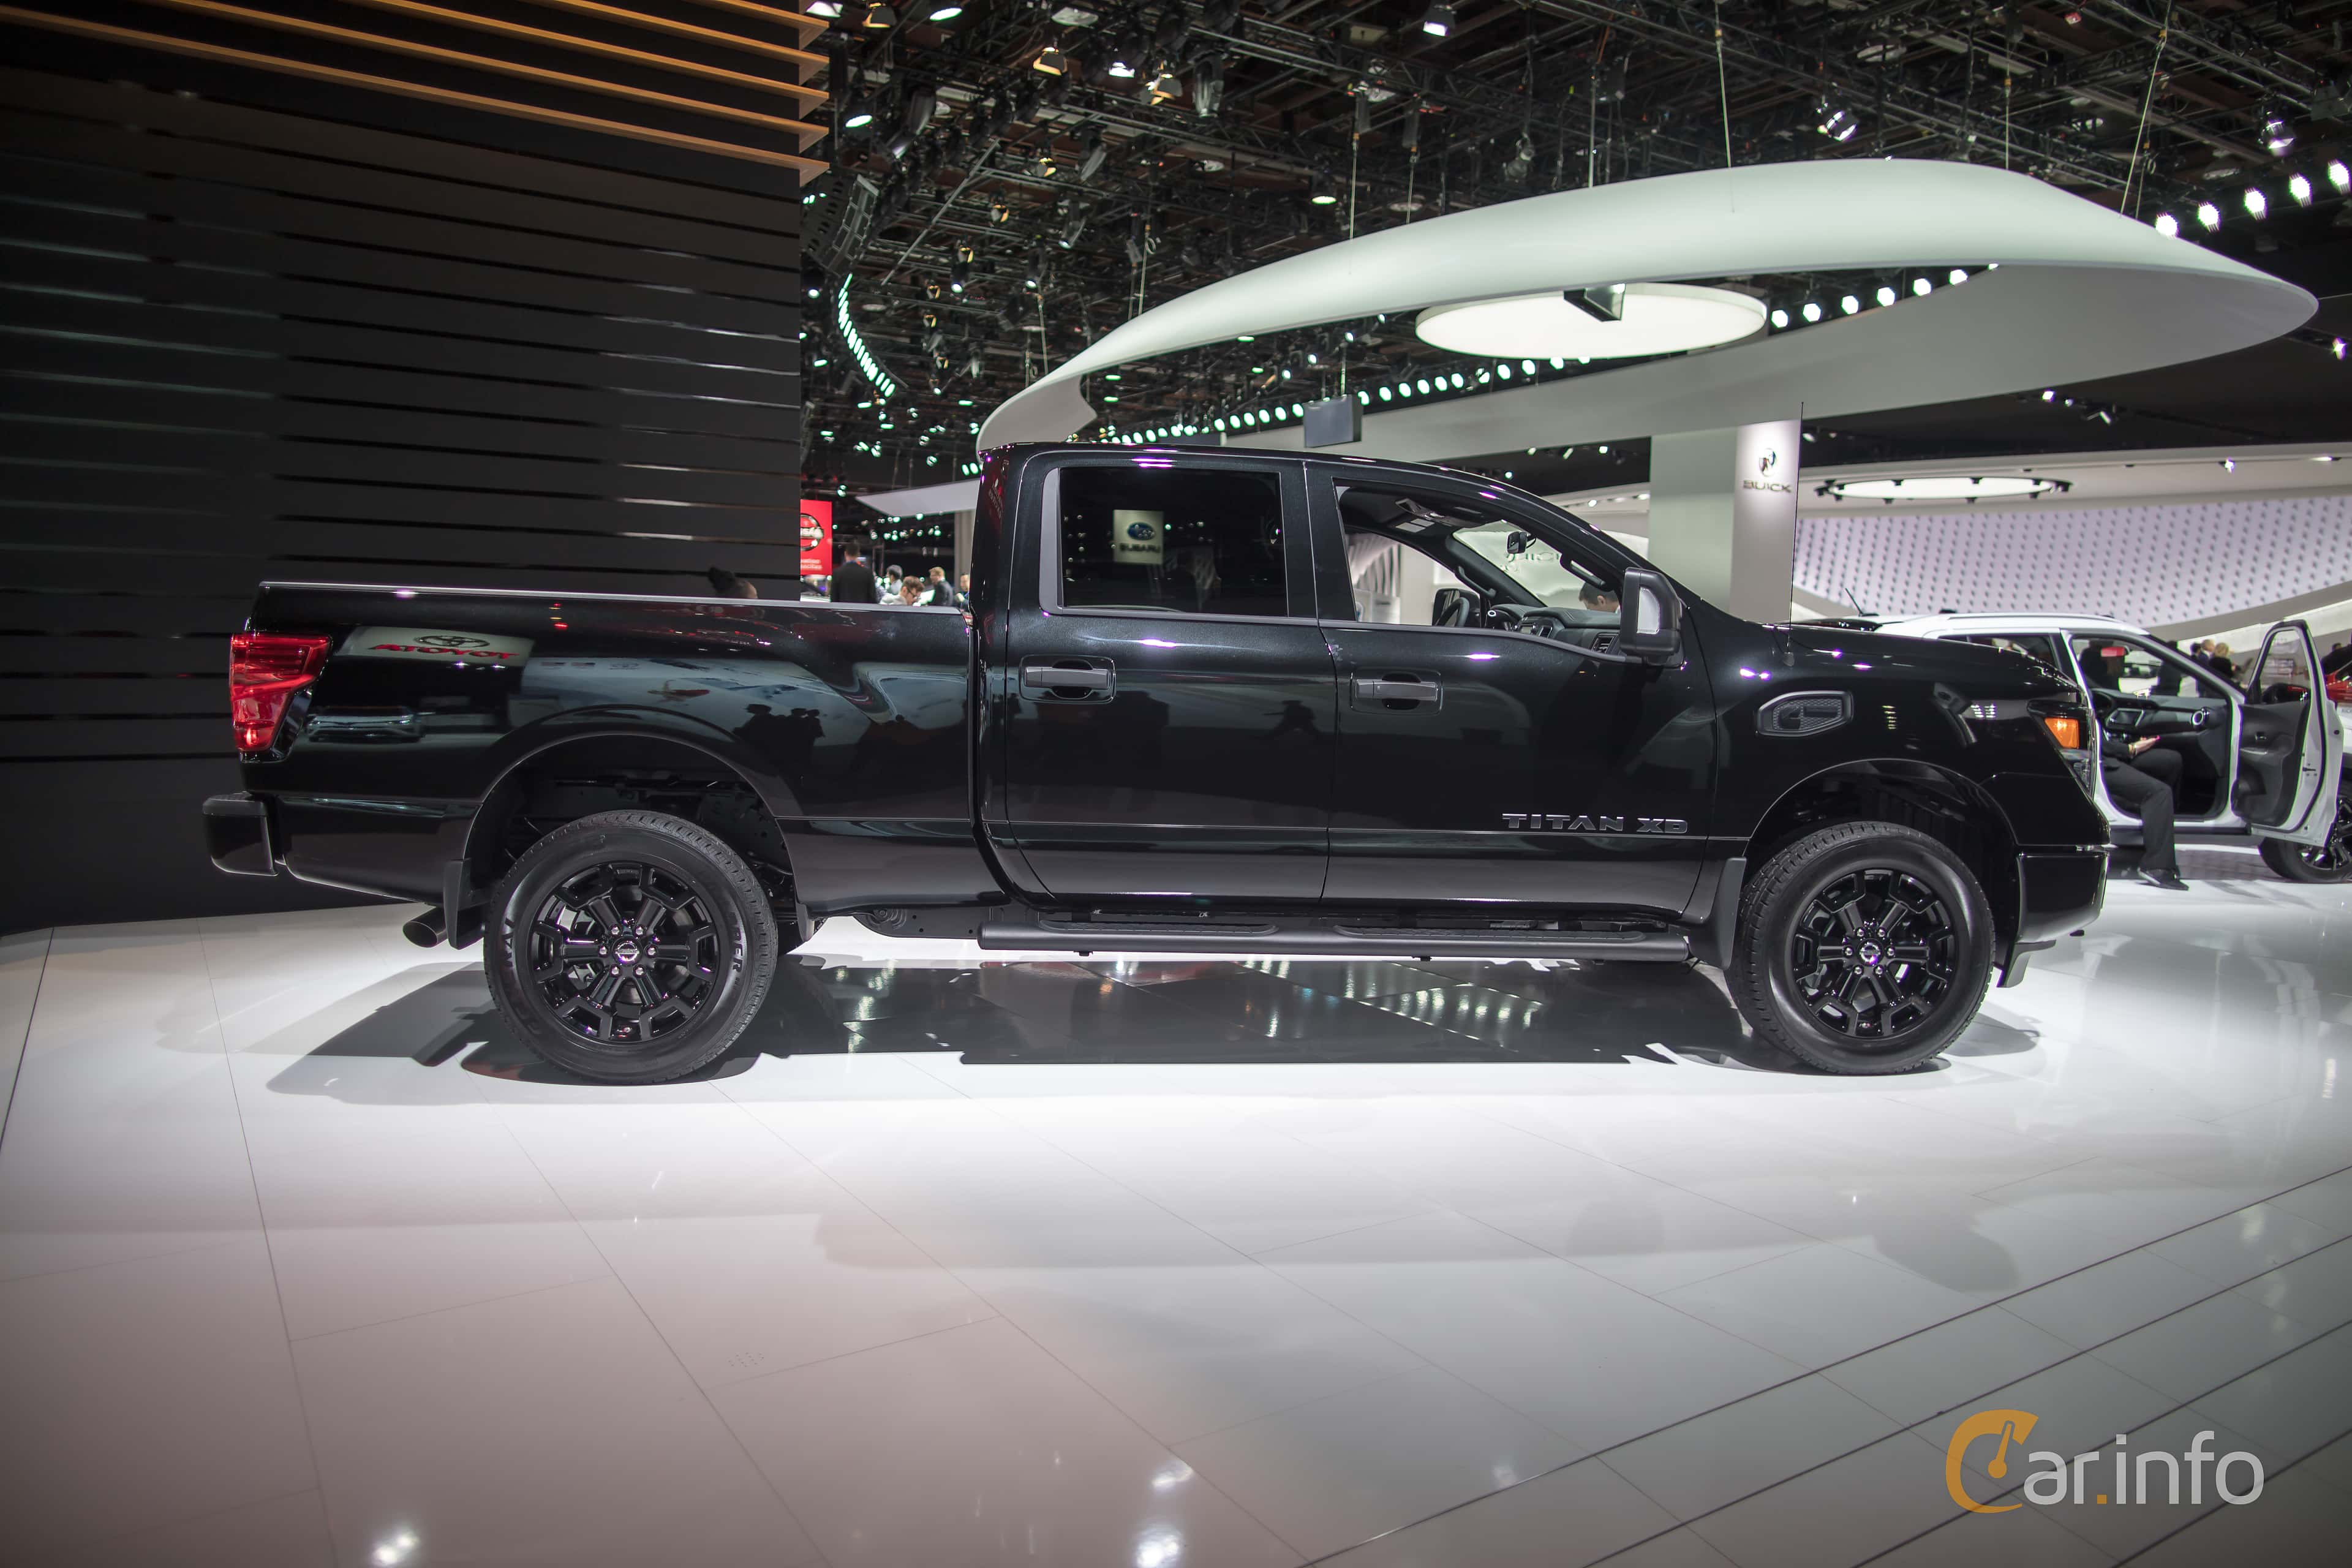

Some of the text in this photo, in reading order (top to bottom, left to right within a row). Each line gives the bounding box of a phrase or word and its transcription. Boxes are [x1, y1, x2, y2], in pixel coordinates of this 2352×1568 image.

[1743, 480, 1792, 493] BUICK
[1501, 813, 1688, 834] TITAN XD
